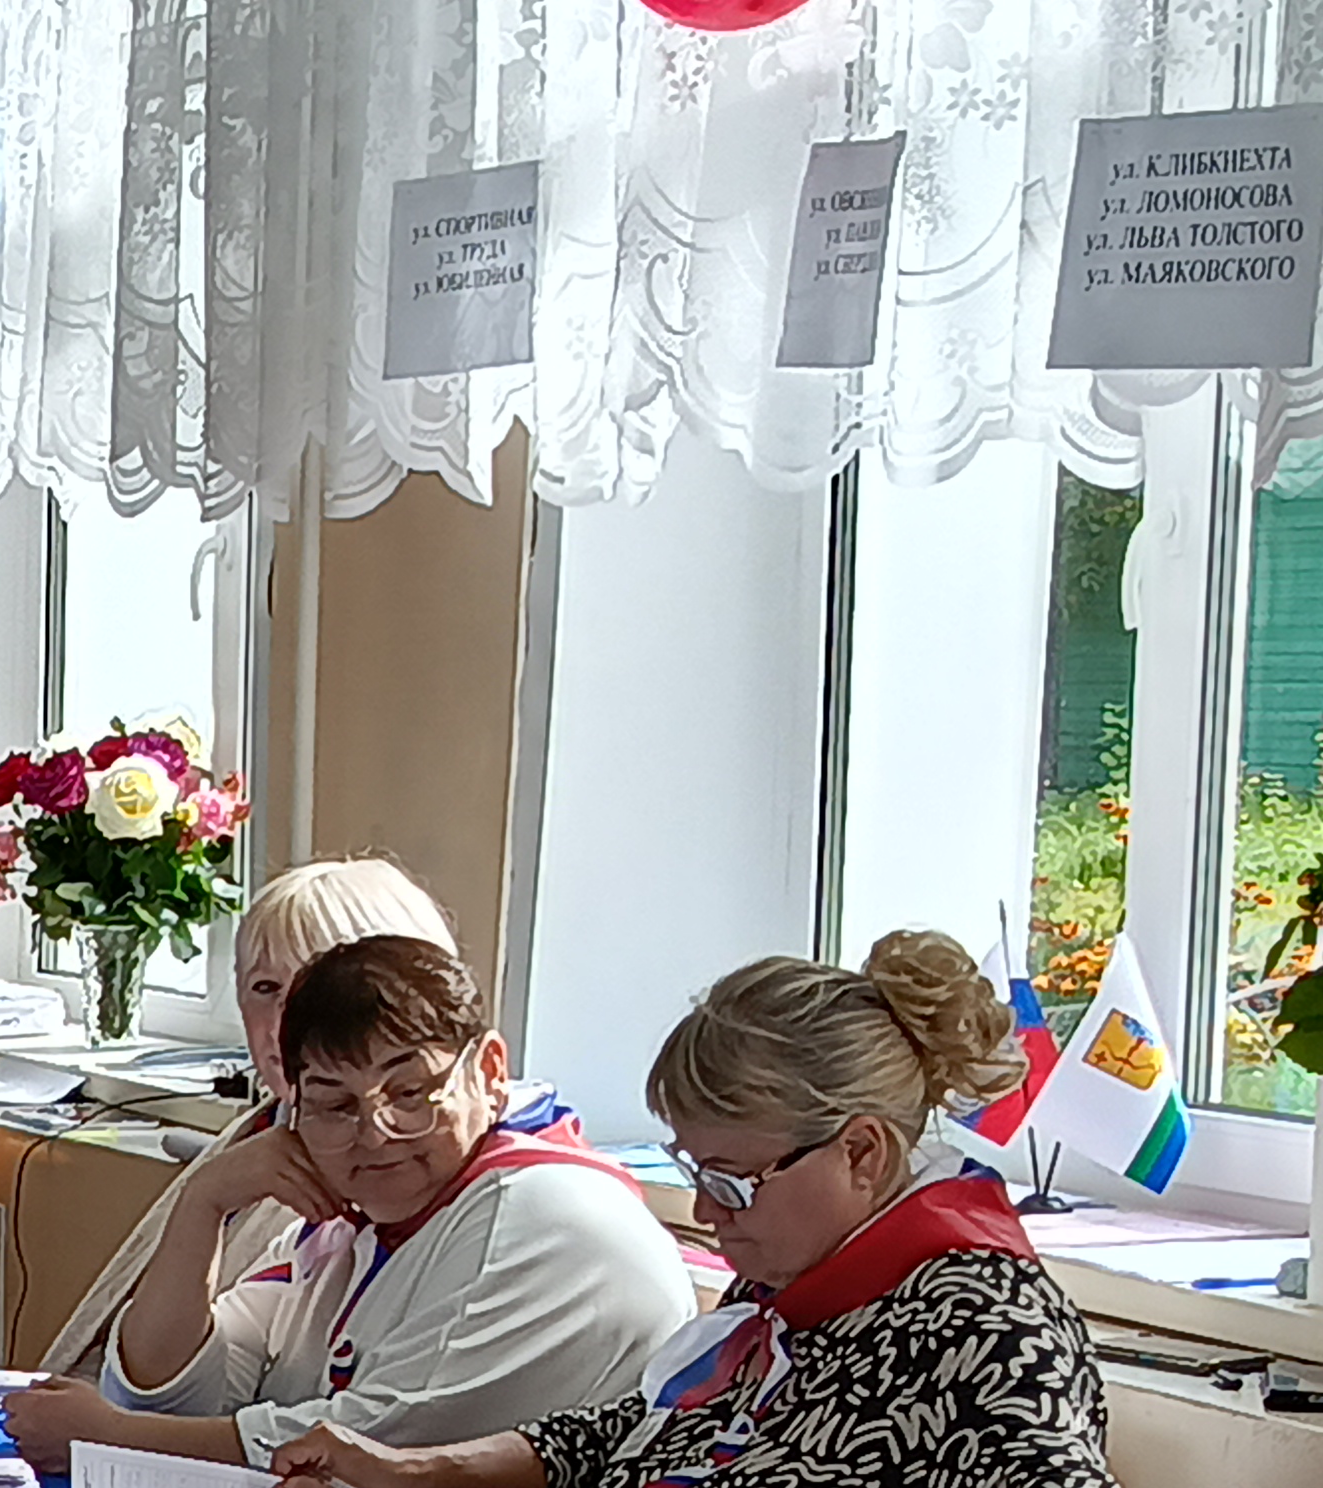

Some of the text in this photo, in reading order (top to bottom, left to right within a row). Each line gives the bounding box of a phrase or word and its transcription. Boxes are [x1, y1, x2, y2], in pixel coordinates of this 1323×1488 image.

[1109, 146, 1293, 187] ул. КЛИБКНЕХТА
[1100, 183, 1294, 222] ул. ЛОМОНОСОВА
[1083, 218, 1304, 257] ул. ЛЬВА ТОЛСТОГО
[1120, 255, 1296, 285] МАЯКОВСКОГО
